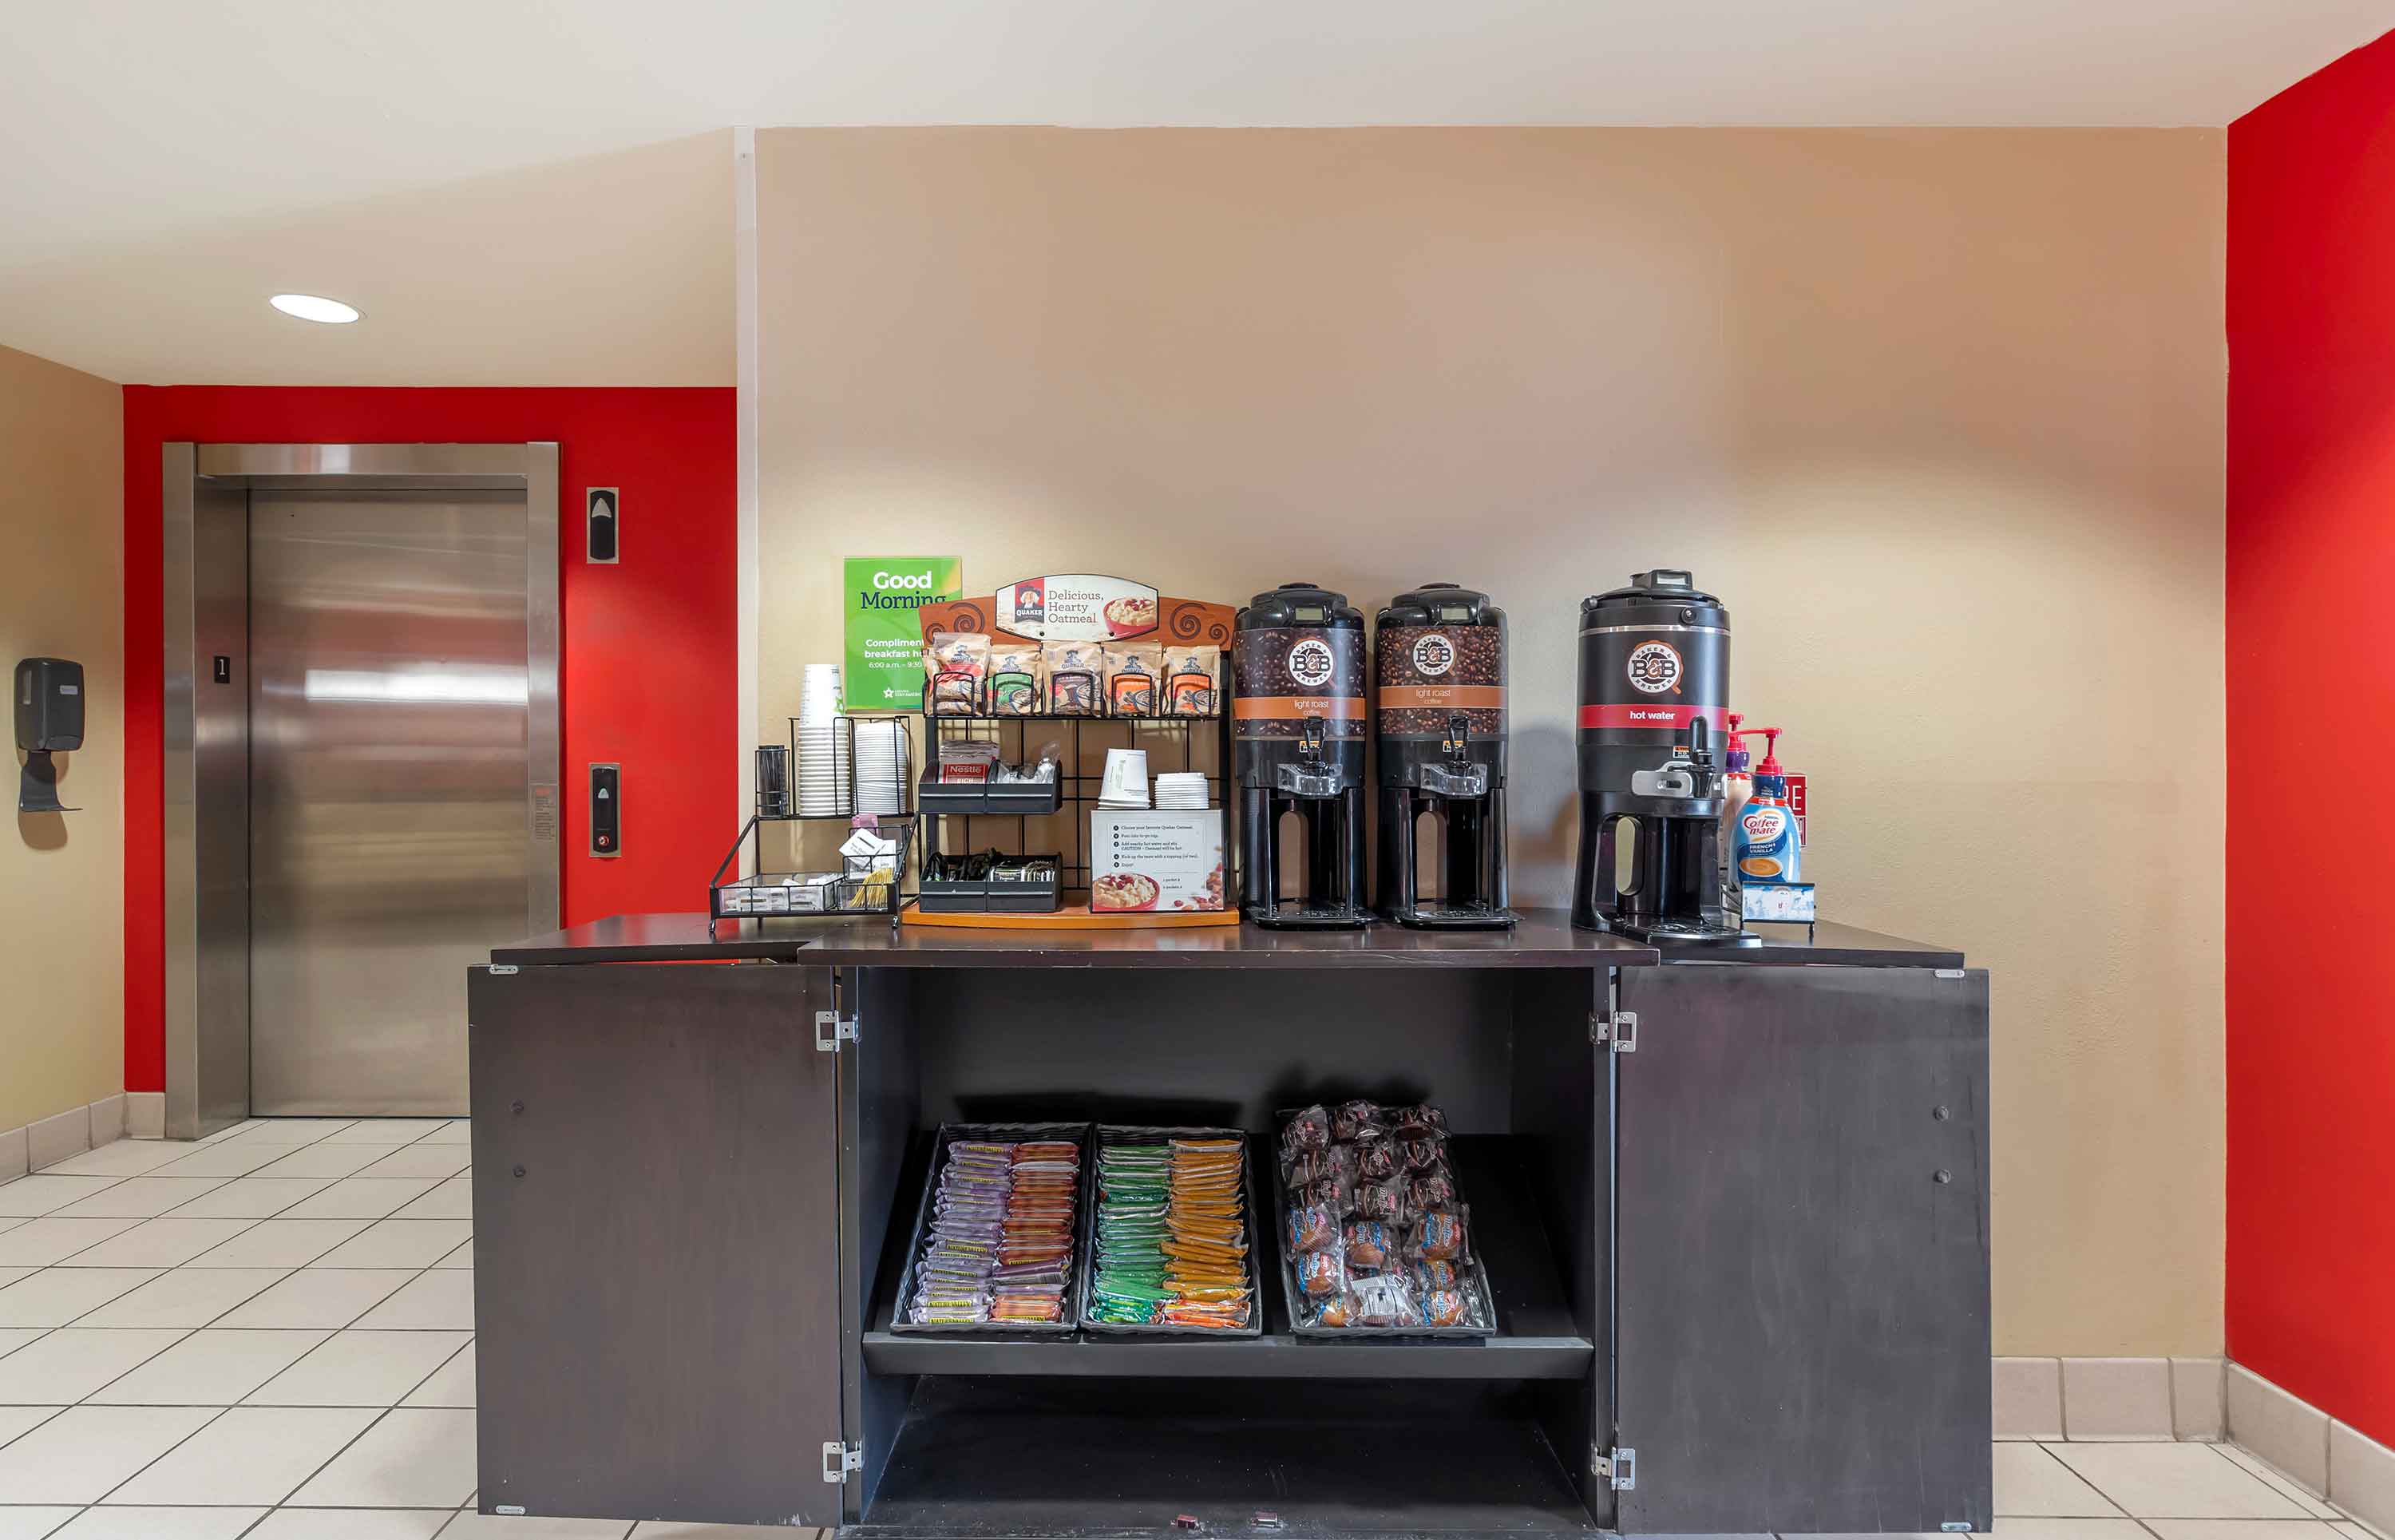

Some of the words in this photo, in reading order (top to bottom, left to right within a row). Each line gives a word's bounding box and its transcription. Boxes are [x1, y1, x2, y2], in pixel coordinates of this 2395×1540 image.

[873, 571, 932, 589] Good
[1048, 590, 1104, 600] Delicious,
[1048, 602, 1089, 614] Hearty
[1048, 613, 1097, 624] Oatmeal
[1416, 647, 1451, 663] B&B
[219, 659, 226, 675] 1
[1293, 655, 1331, 671] B&B
[1631, 659, 1676, 678] B&B
[1629, 711, 1646, 719] hot
[1648, 711, 1676, 720] water
[1744, 815, 1779, 829] Coffee
